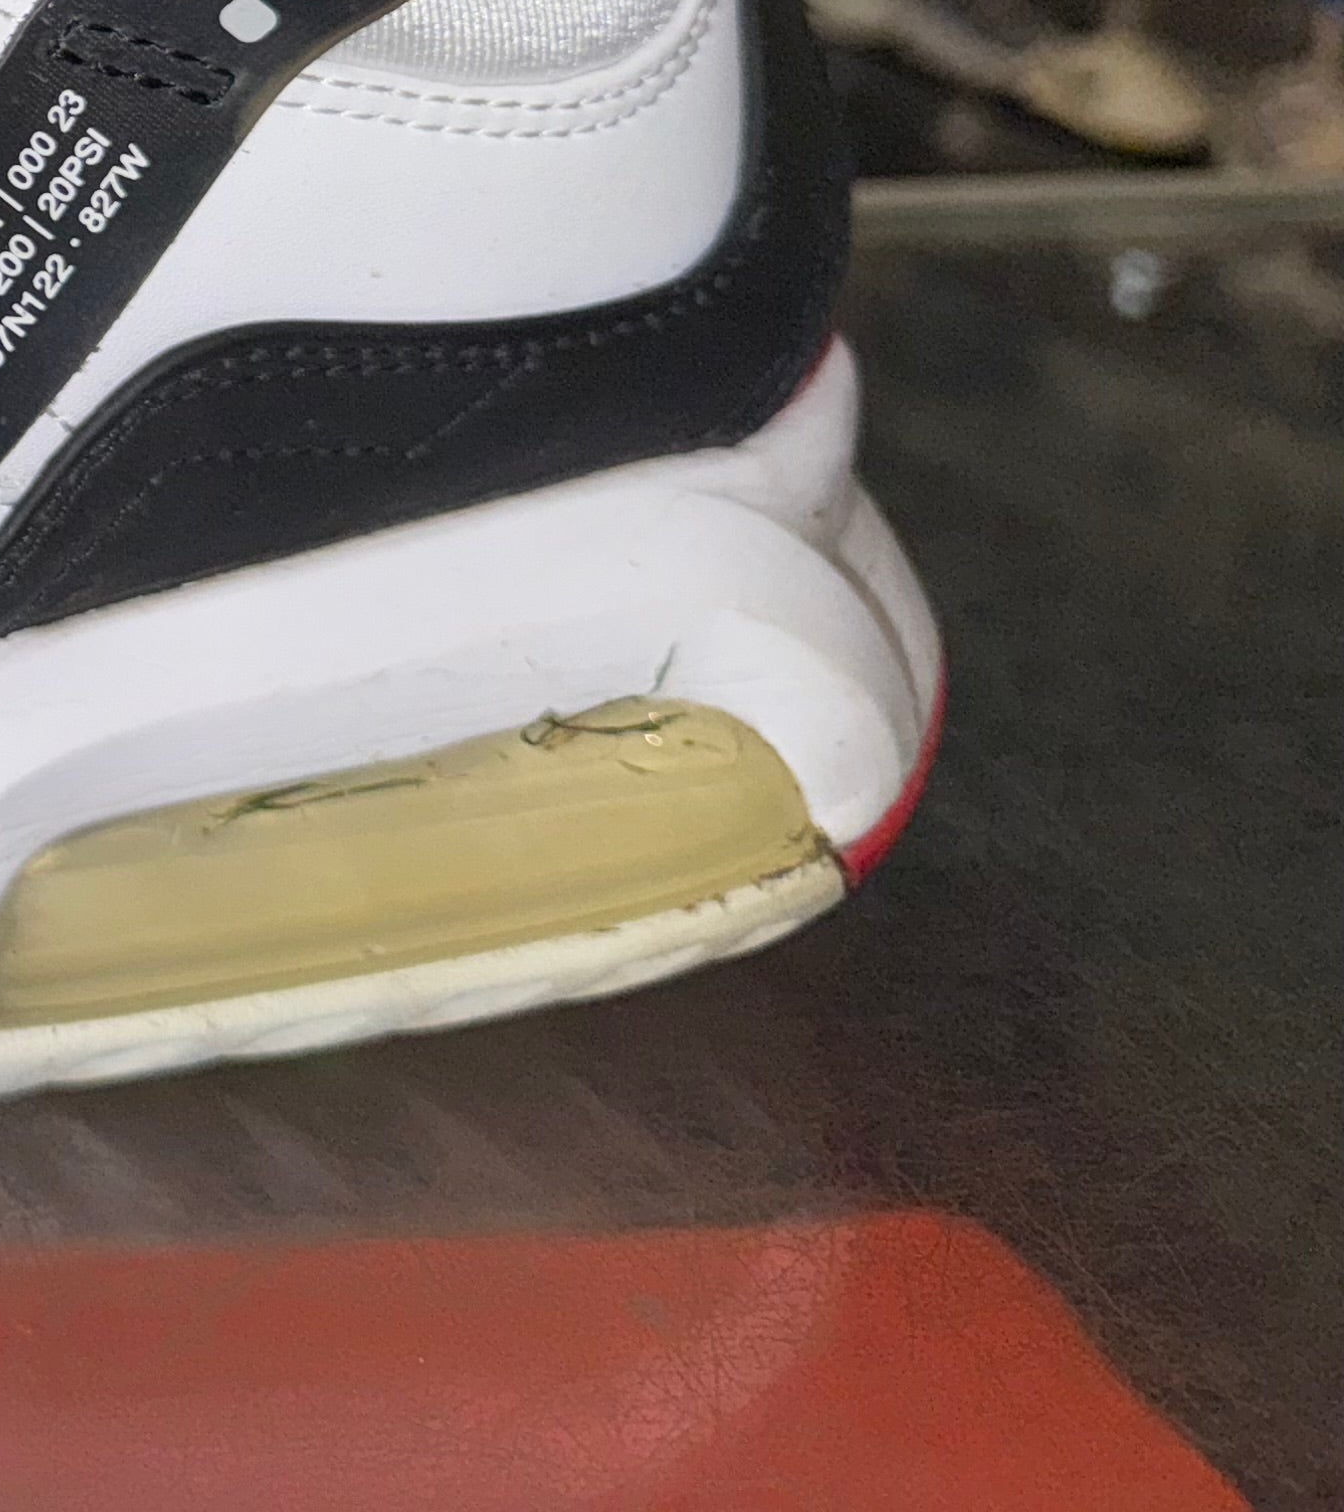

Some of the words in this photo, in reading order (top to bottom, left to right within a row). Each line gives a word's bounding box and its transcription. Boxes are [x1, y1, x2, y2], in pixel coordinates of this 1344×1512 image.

[7, 130, 57, 190] 000
[47, 89, 87, 133] 23
[37, 127, 112, 222] 20PSI
[78, 142, 150, 234] 827W
